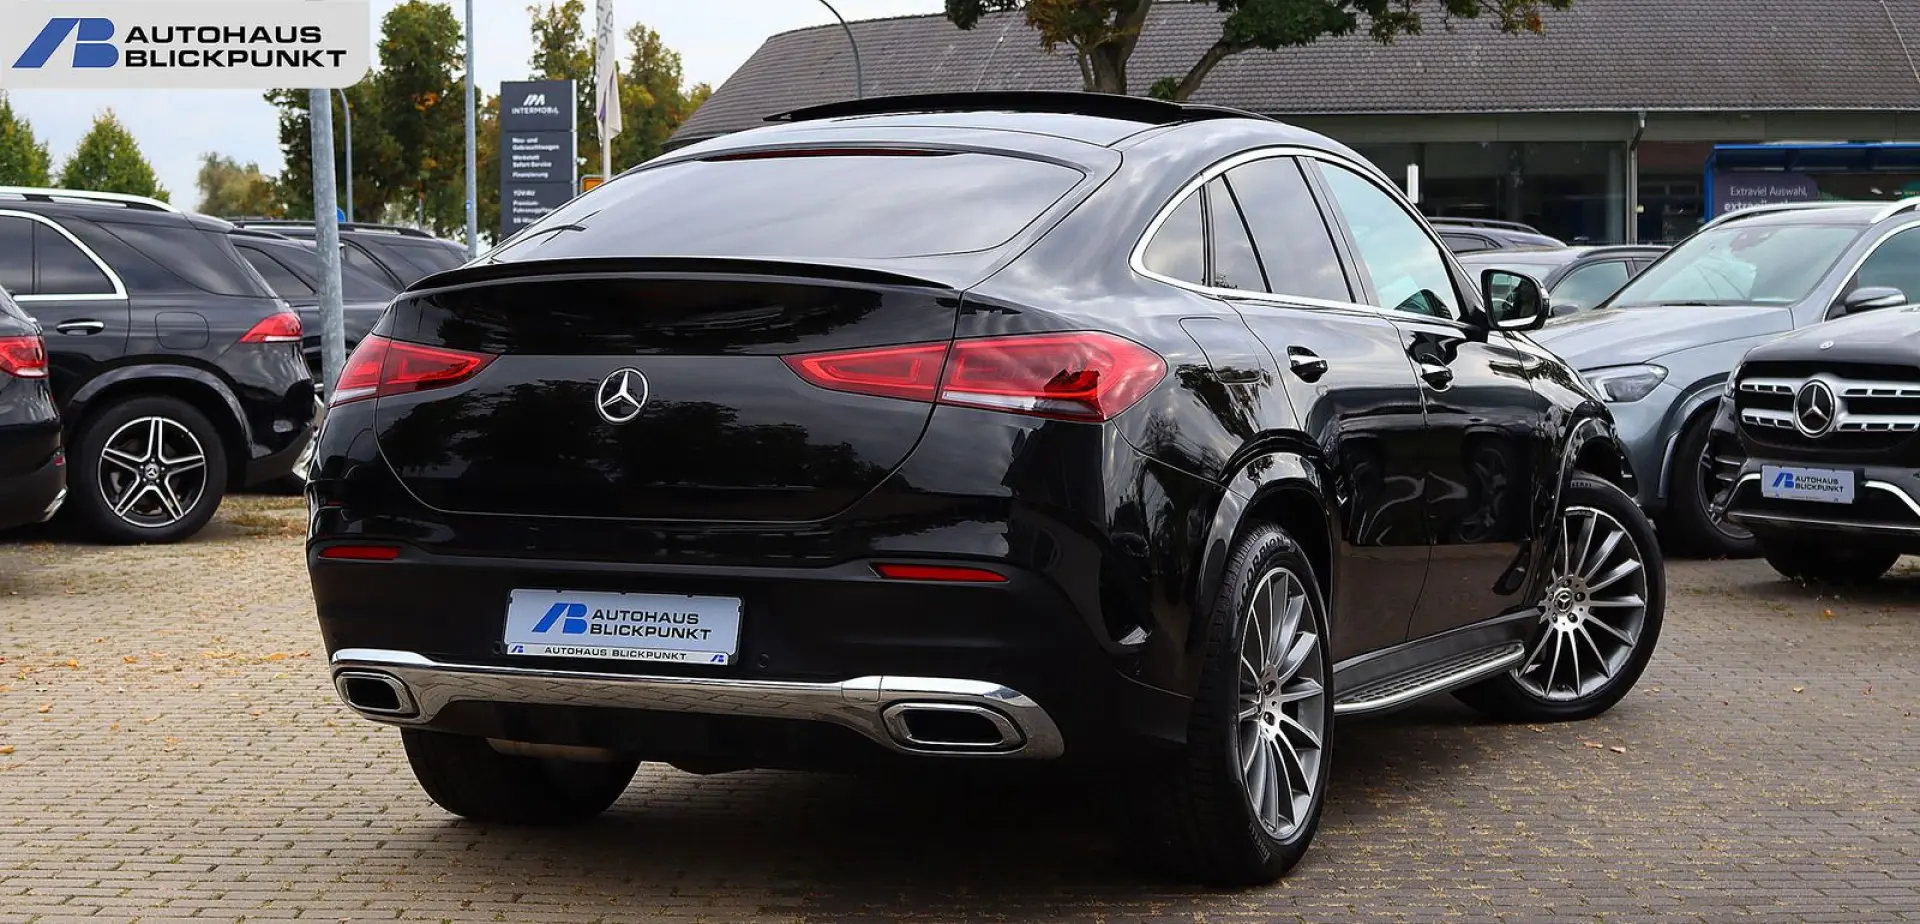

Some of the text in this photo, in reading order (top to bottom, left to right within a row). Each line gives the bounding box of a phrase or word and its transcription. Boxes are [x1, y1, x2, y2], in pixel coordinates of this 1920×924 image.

[1729, 186, 1808, 198] Extraviel Auswahl,
[1795, 475, 1839, 485] AUTOHAUS
[1795, 483, 1844, 493] BLICKPUNKT
[591, 609, 700, 625] AUTOHAUS
[589, 623, 712, 640] BLICKPUNKT
[544, 646, 687, 661] AUTOHAUS BLICKPUNKT
